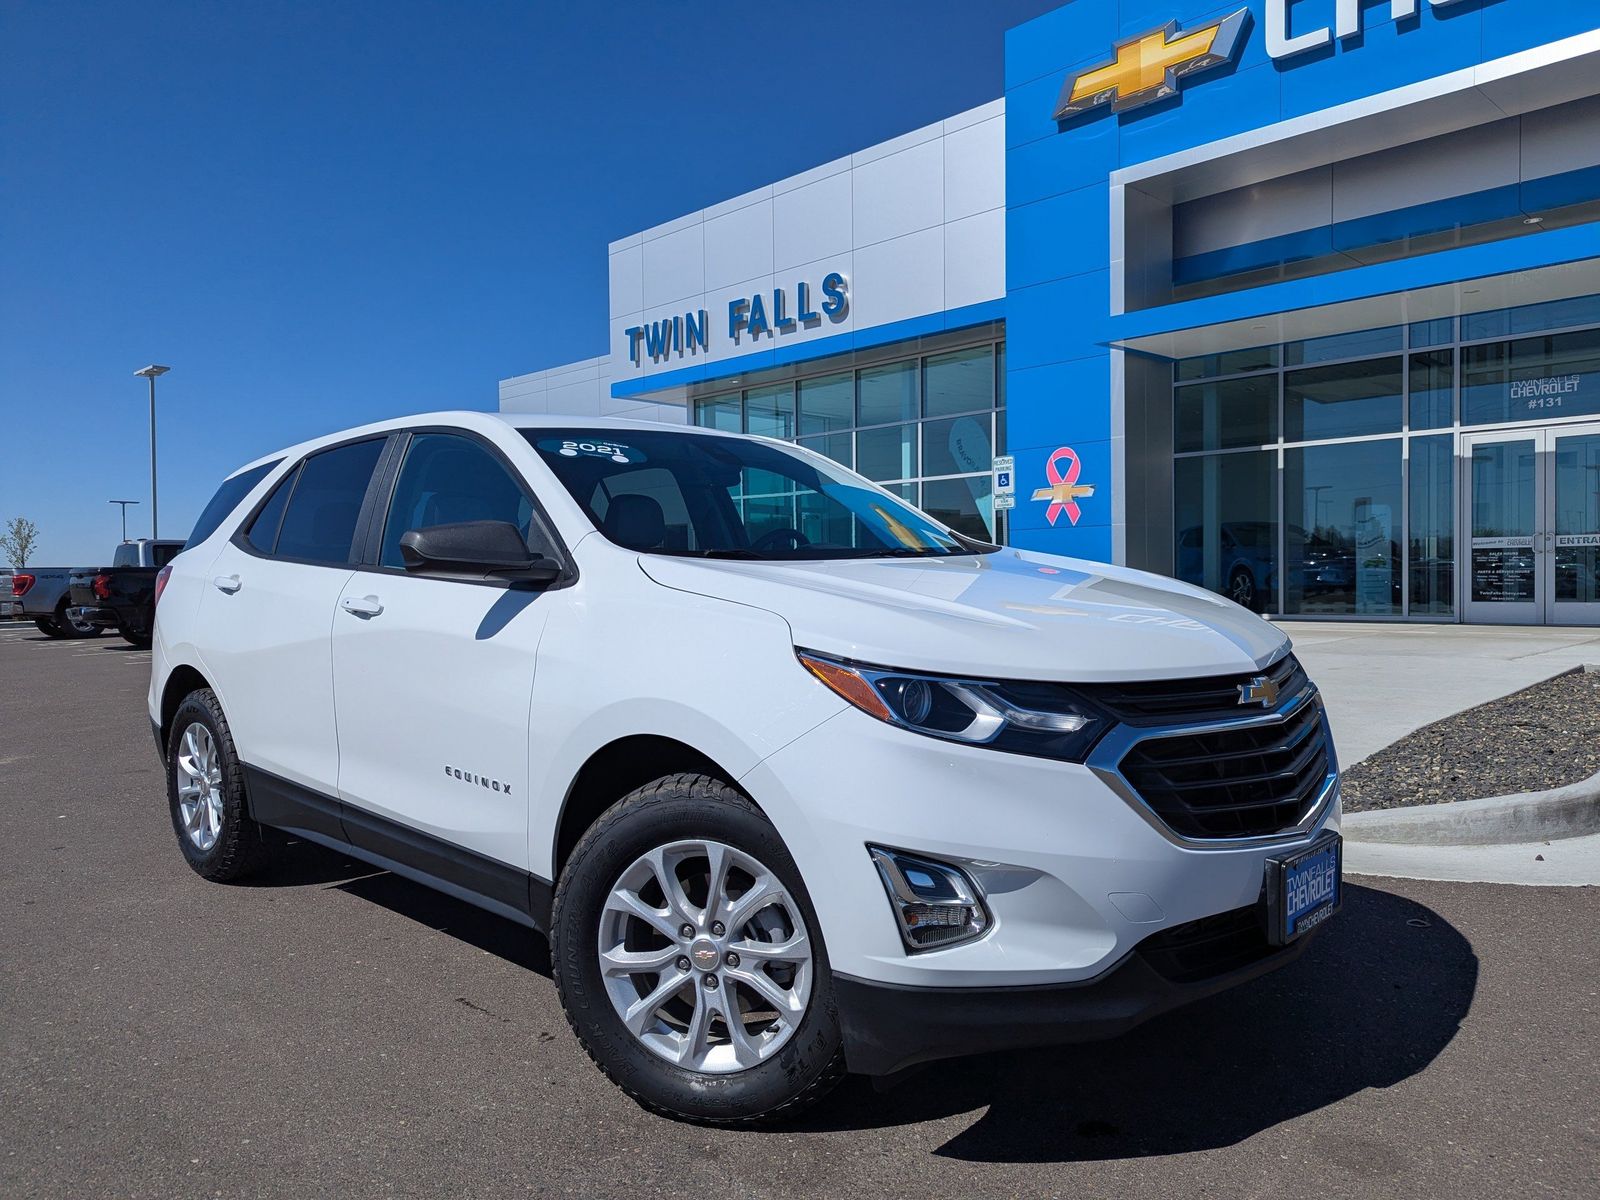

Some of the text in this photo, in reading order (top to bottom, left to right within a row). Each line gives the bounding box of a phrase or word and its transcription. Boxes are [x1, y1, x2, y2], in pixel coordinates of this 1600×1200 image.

[625, 272, 849, 367] TWIN FALLS
[1511, 381, 1580, 398] CHEVROLET
[1528, 397, 1562, 409] #131
[562, 441, 625, 456] 2021
[1560, 536, 1600, 545] ENTRA
[445, 765, 512, 796] EQUINOX
[1287, 856, 1336, 892] TWINFALLS
[1287, 871, 1335, 916] CHEVROLET
